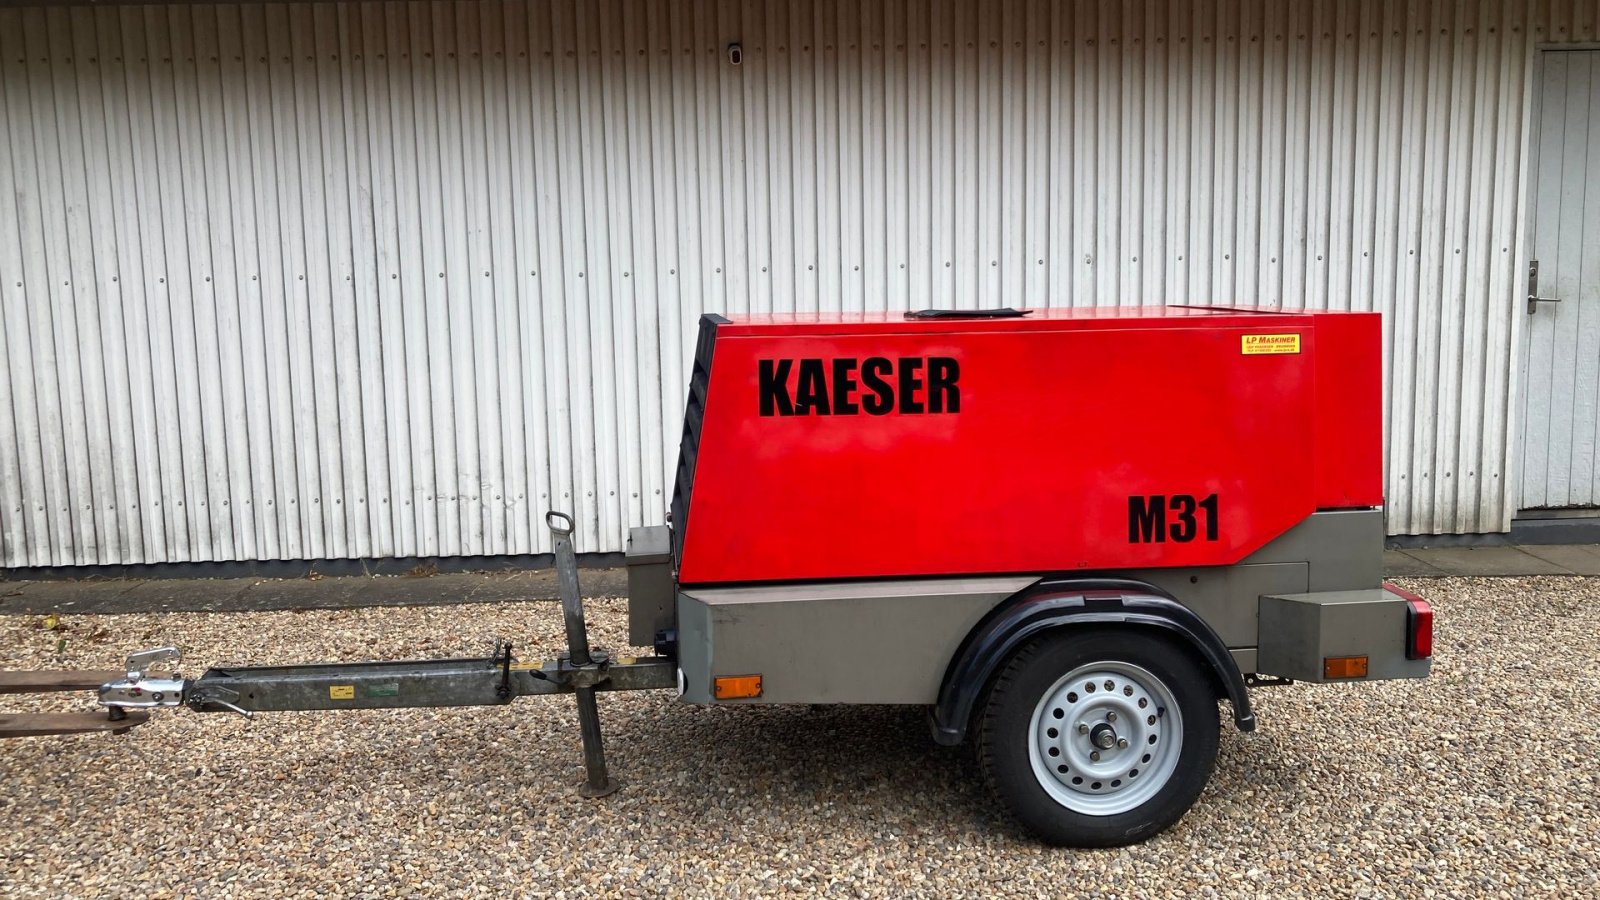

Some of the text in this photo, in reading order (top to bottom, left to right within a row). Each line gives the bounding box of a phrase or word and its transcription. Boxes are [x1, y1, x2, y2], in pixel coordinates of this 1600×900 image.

[1246, 336, 1257, 344] LP
[759, 357, 960, 416] KAESER
[1129, 494, 1218, 543] M31
